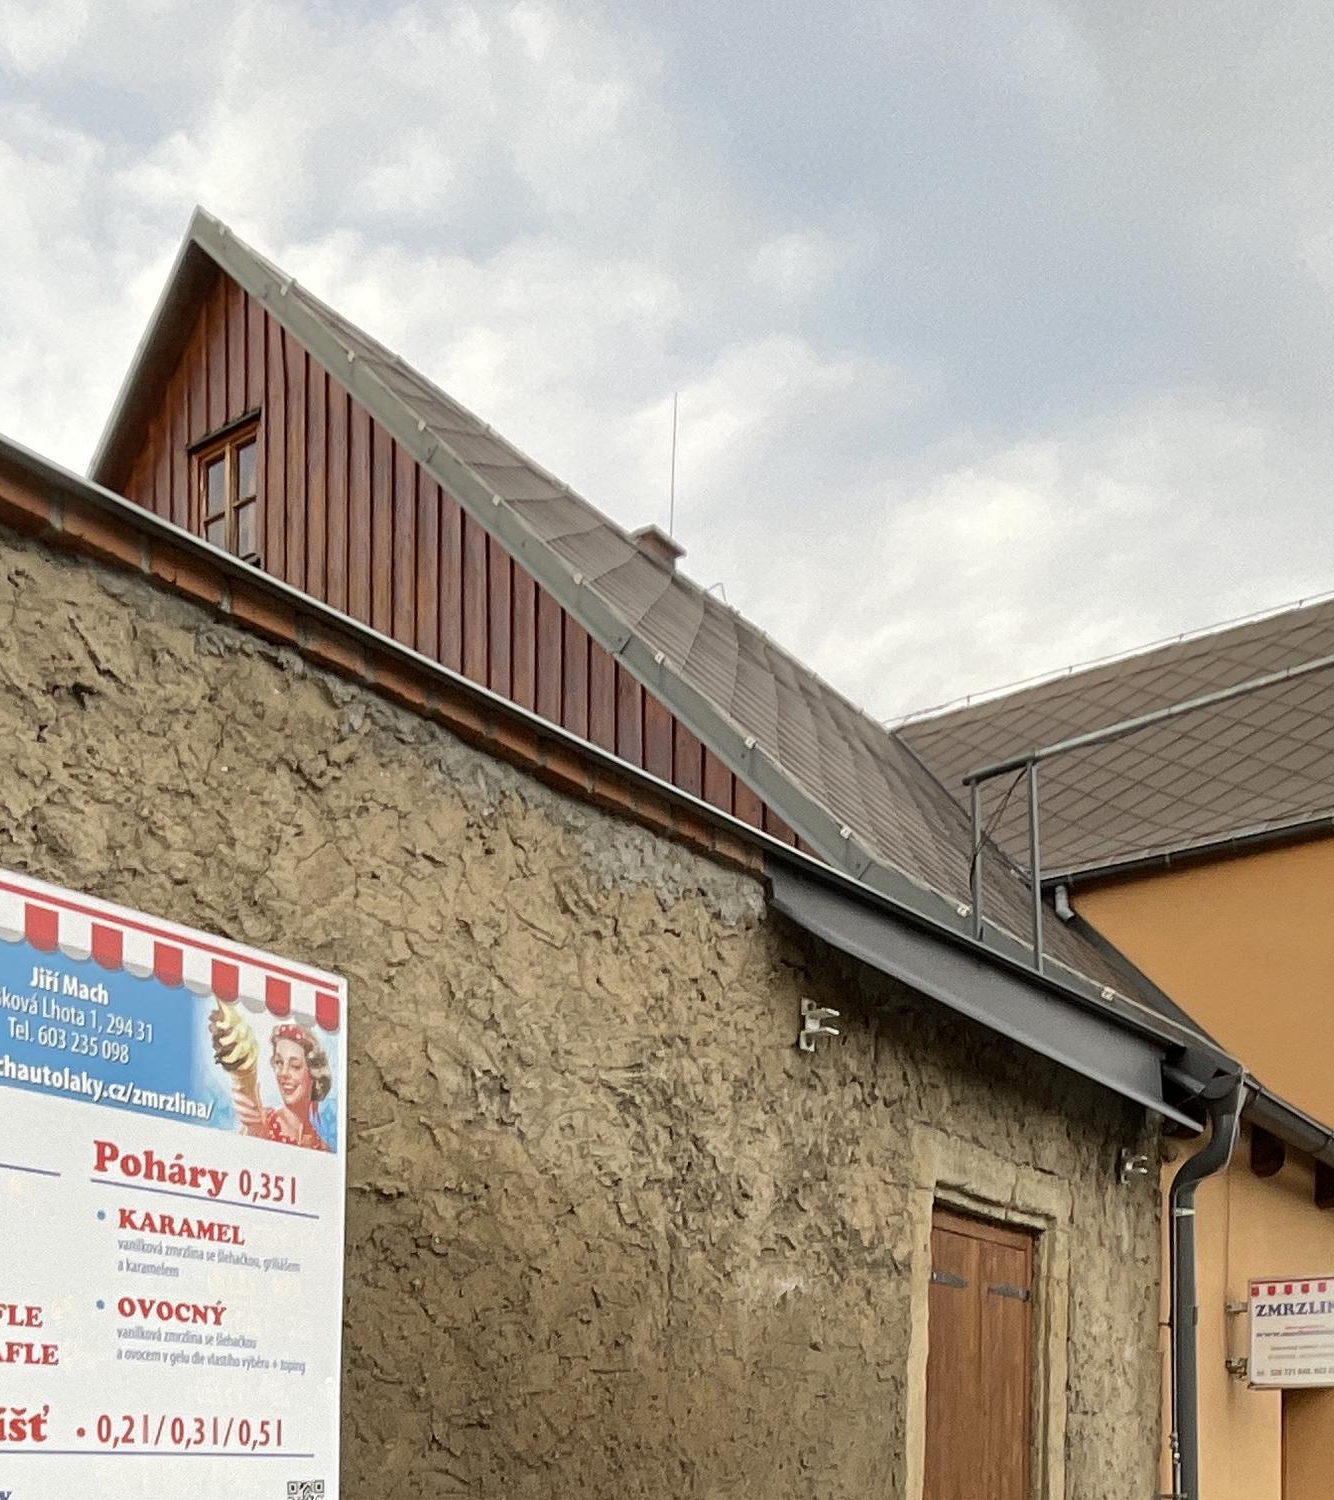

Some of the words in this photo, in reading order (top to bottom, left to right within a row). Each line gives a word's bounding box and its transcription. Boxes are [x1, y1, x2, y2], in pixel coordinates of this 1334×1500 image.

[30, 966, 59, 993] Jiří
[63, 974, 109, 1006] Mach
[43, 996, 85, 1025] Lhota
[91, 1009, 103, 1033] 1,
[106, 1014, 133, 1038] 294
[137, 1021, 153, 1043] 31
[8, 1016, 32, 1042] Tel.
[38, 1025, 66, 1049] 603
[71, 1032, 98, 1056] 235
[102, 1041, 129, 1064] 098
[93, 1140, 228, 1198] Poháry
[118, 1208, 245, 1245] KARAMEL
[118, 1261, 123, 1271] a
[118, 1297, 227, 1326] OVOCNÝ
